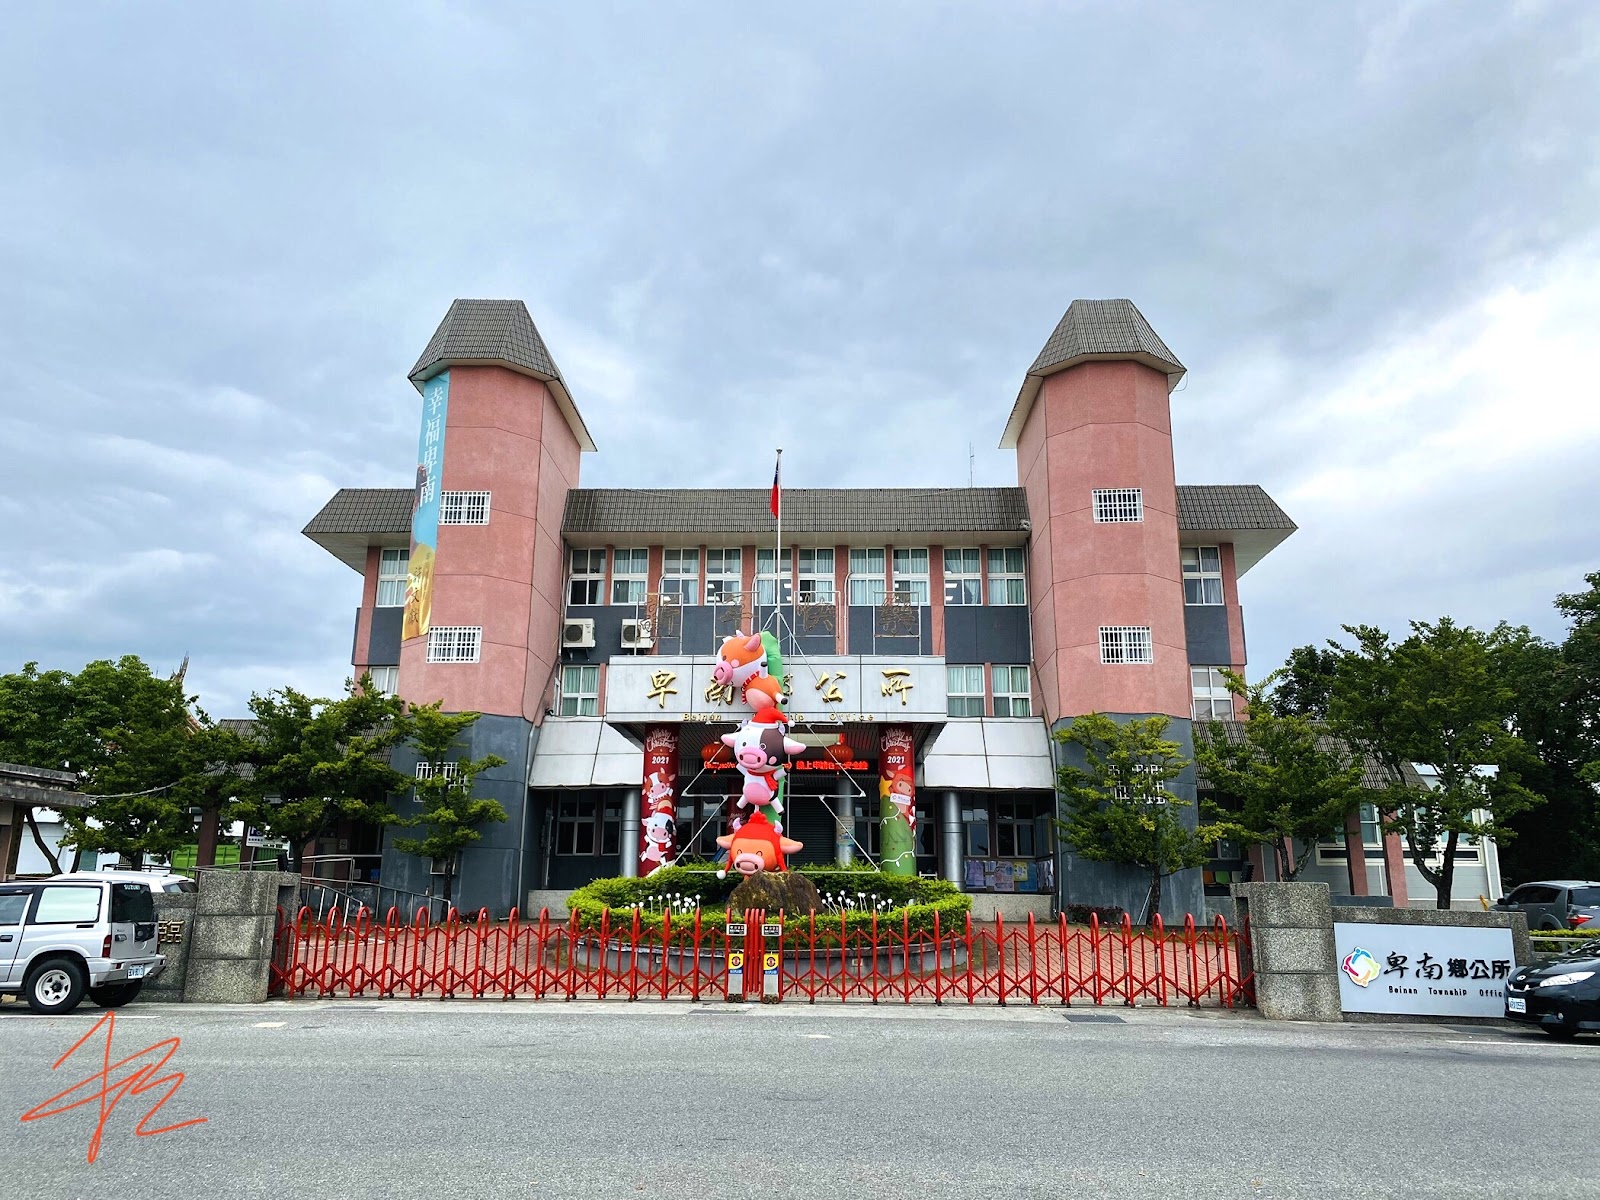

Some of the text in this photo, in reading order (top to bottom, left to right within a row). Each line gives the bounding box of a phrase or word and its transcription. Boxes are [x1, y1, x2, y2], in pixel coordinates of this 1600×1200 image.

[419, 386, 443, 508] 幸福卑南
[683, 713, 874, 721] Beinan Office
[651, 756, 669, 764] 2021
[1384, 951, 1510, 980] 卑南鄉公所
[1389, 986, 1503, 997] Beinan Township Offic
